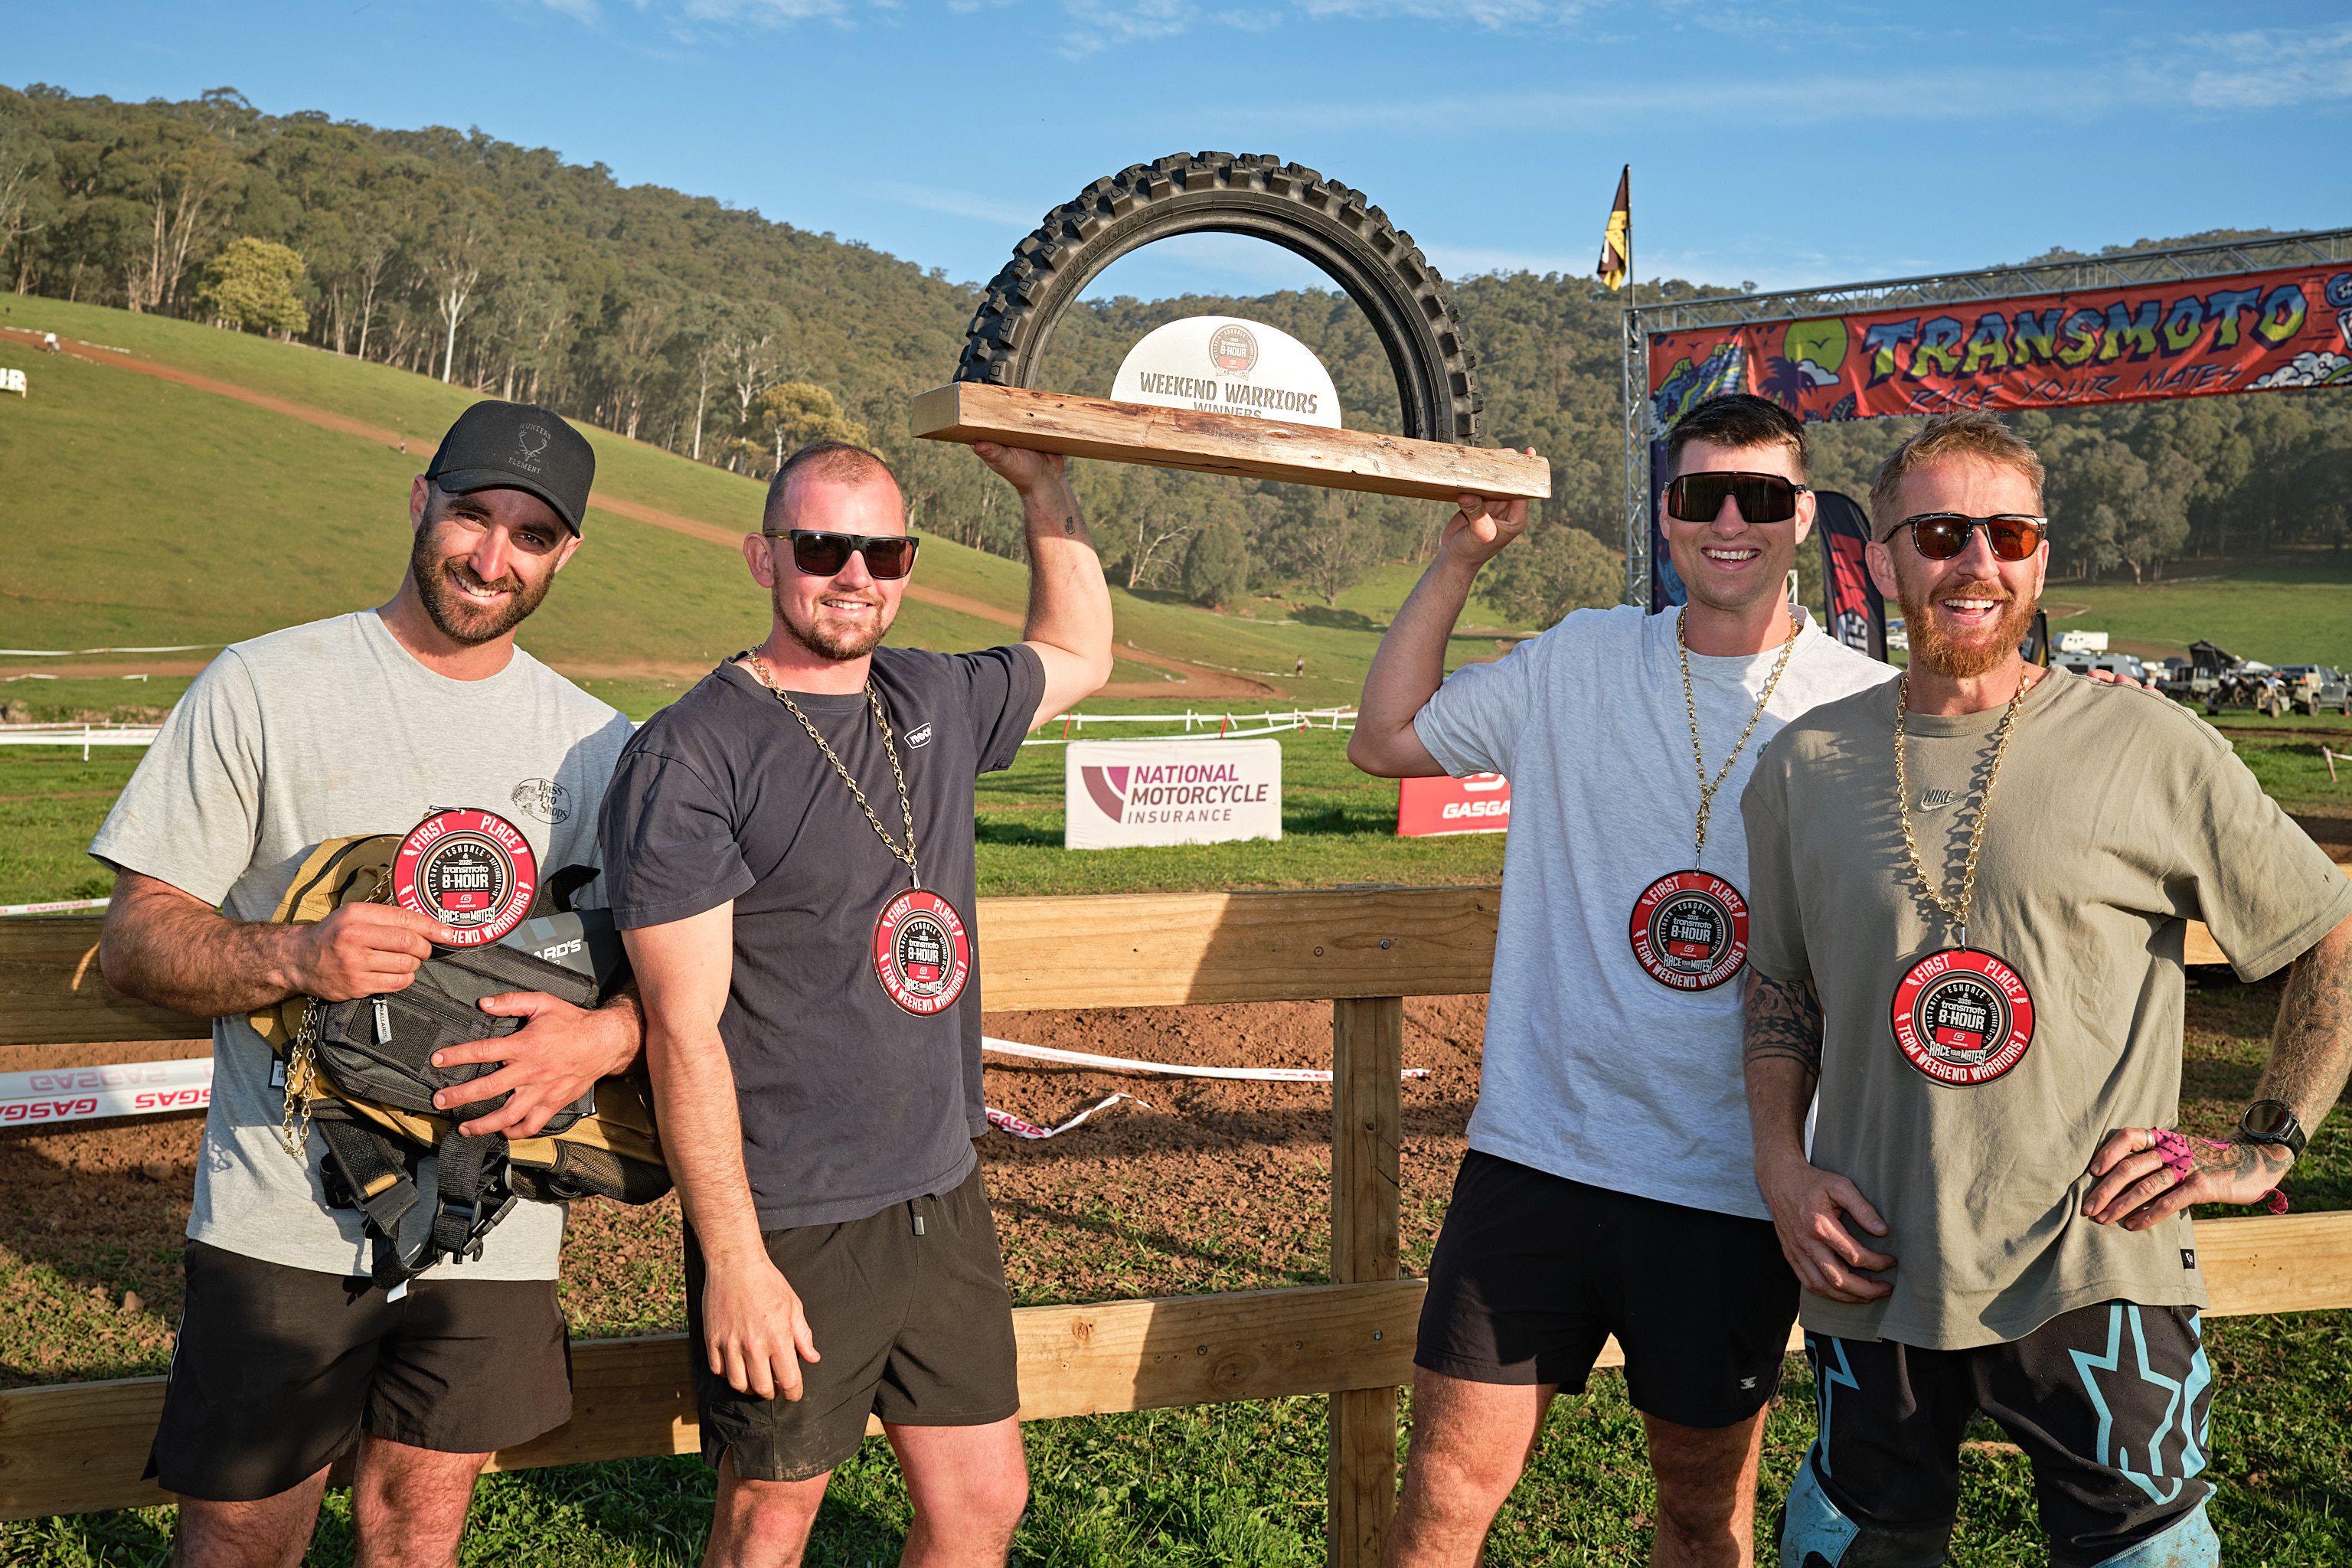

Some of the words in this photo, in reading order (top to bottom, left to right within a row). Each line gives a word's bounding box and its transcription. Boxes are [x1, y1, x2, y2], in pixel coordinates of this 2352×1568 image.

[1221, 339, 1247, 348] transmoto
[1864, 284, 2308, 388] TRANSMOTO
[1220, 345, 1246, 358] 8-HOUR
[1140, 371, 1217, 400] WEEKEND
[1225, 383, 1318, 414] WARRIORS
[1905, 384, 2004, 413] RACE
[2018, 375, 2120, 404] YOUR
[2135, 362, 2243, 393] MATES
[519, 423, 551, 440] HUNTERS
[508, 457, 541, 474] ELEMENT
[1134, 763, 1240, 784] NATIONAL
[538, 779, 563, 795] Bass
[1131, 783, 1269, 806] MOTORCYCLE
[1922, 789, 1955, 803] NIKE
[540, 792, 557, 805] Pro
[539, 802, 568, 820] Shops
[1127, 808, 1232, 825] INSURANCE
[1442, 800, 1511, 819] GASGA
[410, 818, 447, 850] FIRST
[479, 815, 521, 849] PLACE
[430, 859, 441, 897] VICTORIA
[443, 864, 489, 874] transmoto
[442, 874, 489, 888] 8-HOUR
[1648, 876, 1681, 902] FIRST
[1708, 879, 1743, 912] PLACE
[437, 907, 460, 923] RACE
[470, 906, 496, 924] MATES!
[450, 929, 481, 944] KEND
[482, 891, 530, 940] WARRIORS
[887, 896, 912, 923] FIRST
[933, 898, 960, 931] PLACE
[1673, 916, 1713, 929] transmoto
[1661, 911, 1673, 942] VICTORIA
[1671, 925, 1711, 942] 8-HOUR
[534, 938, 582, 960] ARD'S
[900, 933, 909, 966] VICTORIA
[907, 946, 939, 963] 8-HOUR
[908, 939, 939, 950] transmoto
[1635, 939, 1655, 968] TEAM
[1652, 962, 1697, 988] WEEKEND
[1698, 949, 1744, 987] WARRIORS
[1663, 952, 1682, 968] RACE
[1690, 958, 1713, 974] MATES!
[1914, 953, 1951, 982] FIRST
[1983, 959, 2023, 997] PLACE
[881, 963, 900, 993] TEAM
[897, 987, 933, 1011] WEEKEND
[933, 969, 965, 1010] WARRIORS
[904, 976, 920, 992] RACE
[926, 979, 943, 996] MATES!
[1926, 994, 1941, 1028] VICTORIA
[1941, 1000, 1987, 1016] transmoto
[1938, 1010, 1985, 1031] 8-HOUR
[1897, 1024, 1921, 1056] TEAM
[1916, 1051, 1968, 1082] WEEKEND
[1970, 1040, 2024, 1081] WARRIORS
[1929, 1039, 1951, 1057] RACE
[1960, 1049, 1988, 1067] MATES!
[135, 1088, 211, 1109] GAS
[0, 1098, 98, 1121] GASG
